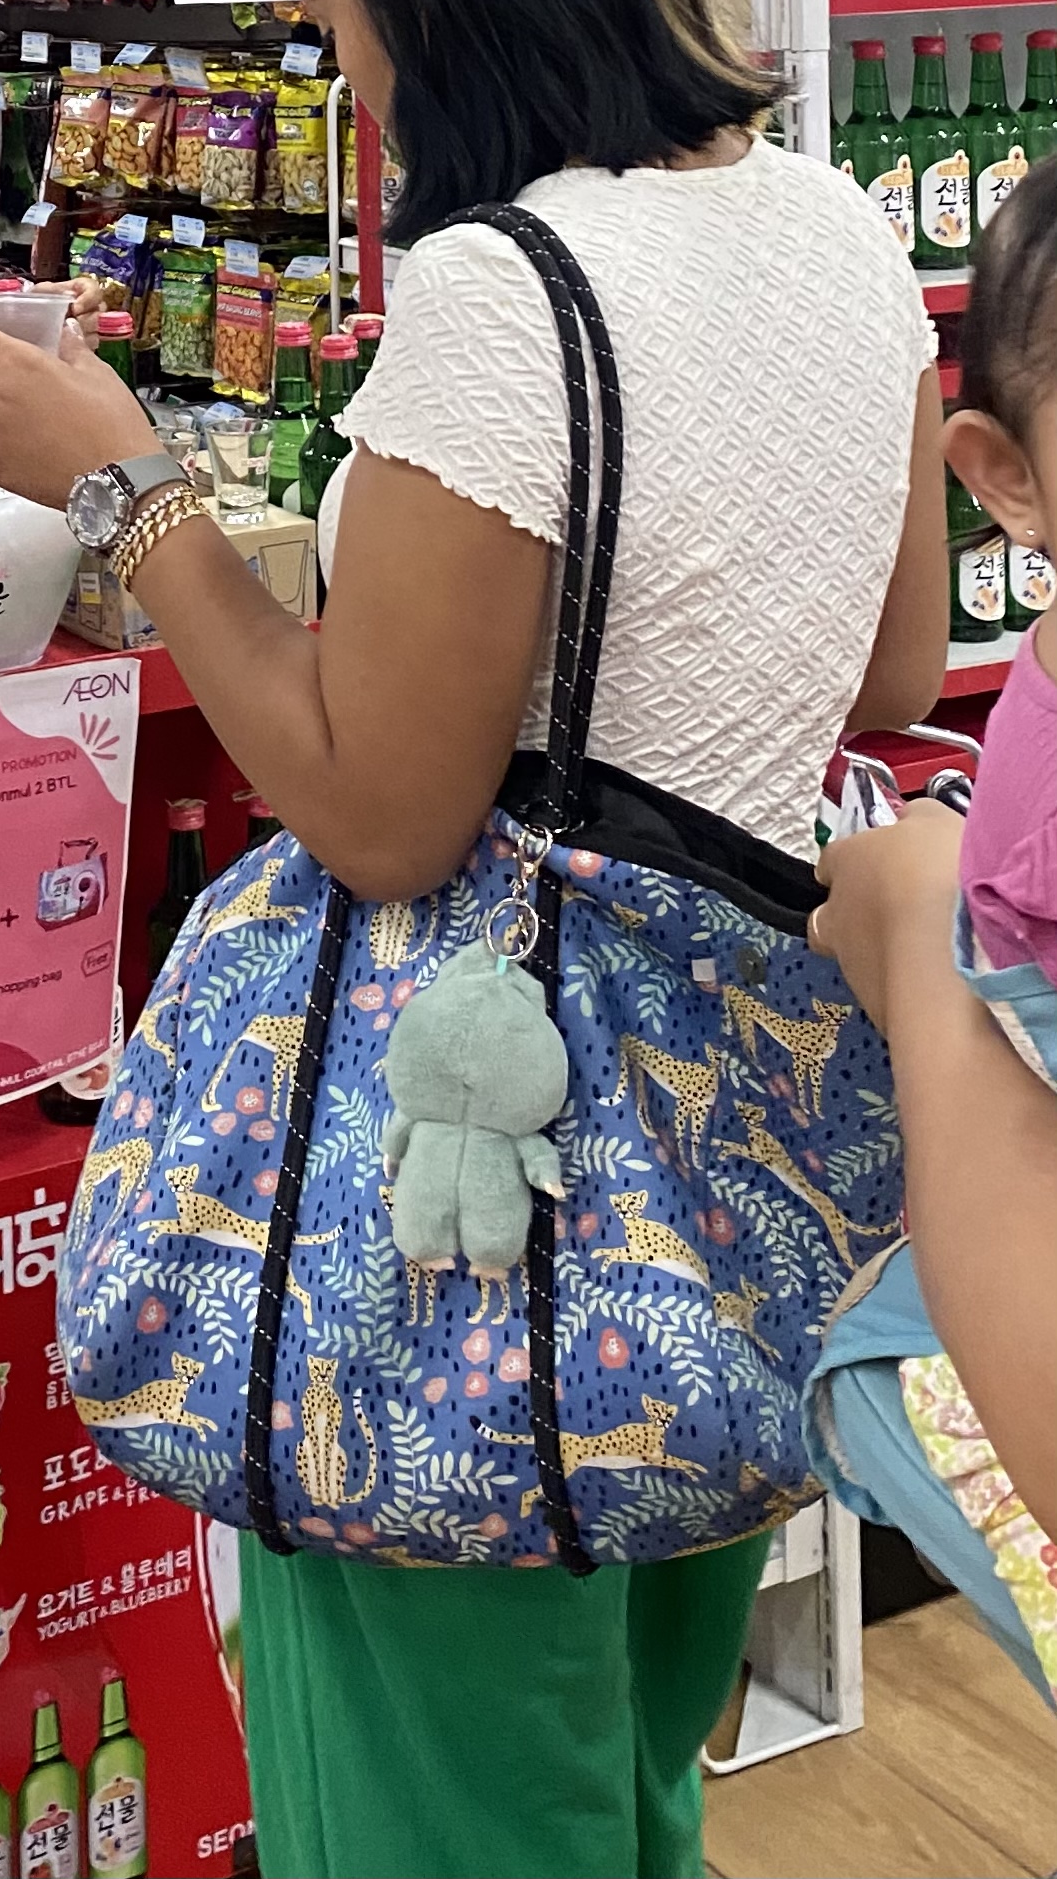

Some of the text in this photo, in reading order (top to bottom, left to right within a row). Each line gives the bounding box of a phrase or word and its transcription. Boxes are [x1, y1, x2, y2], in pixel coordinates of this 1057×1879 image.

[1, 748, 78, 774] PROMOTION
[34, 781, 44, 795] 2
[46, 776, 78, 792] BTL
[36, 1579, 95, 1619] 요거트
[120, 1545, 192, 1594] 블루베리
